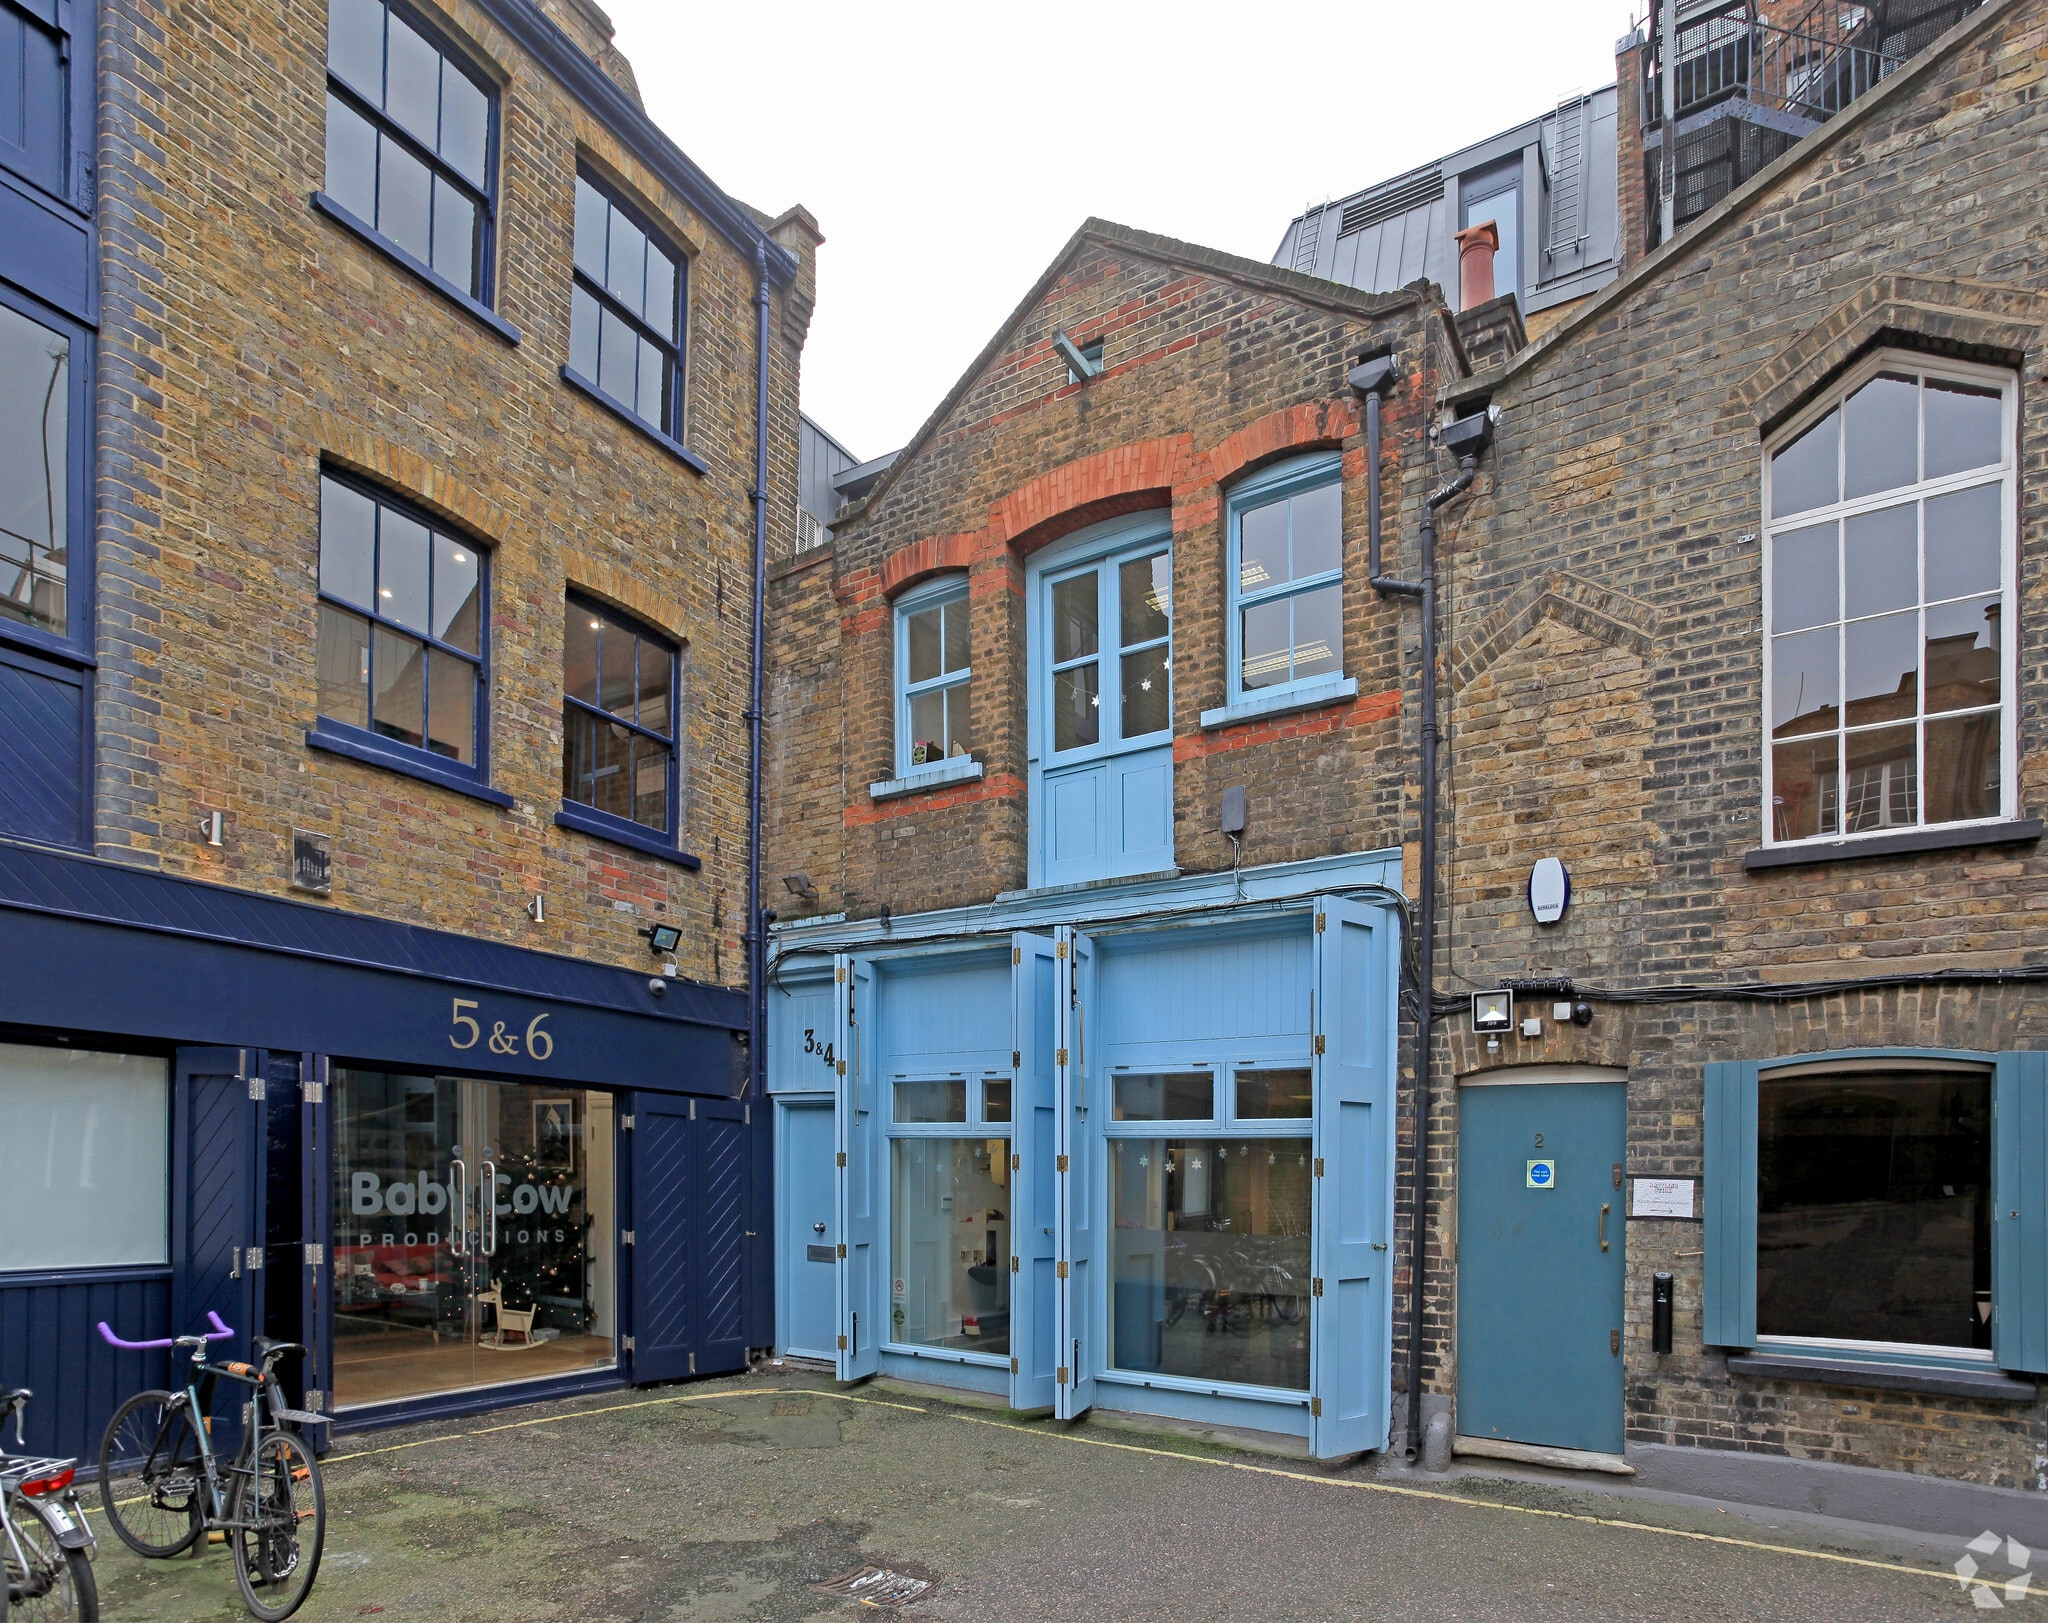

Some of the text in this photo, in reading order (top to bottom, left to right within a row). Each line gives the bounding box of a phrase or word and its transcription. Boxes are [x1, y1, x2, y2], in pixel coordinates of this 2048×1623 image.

[1535, 1133, 1544, 1148] 2
[352, 1170, 573, 1227] Baby Cow
[360, 1229, 565, 1248] PRODUCIONS
